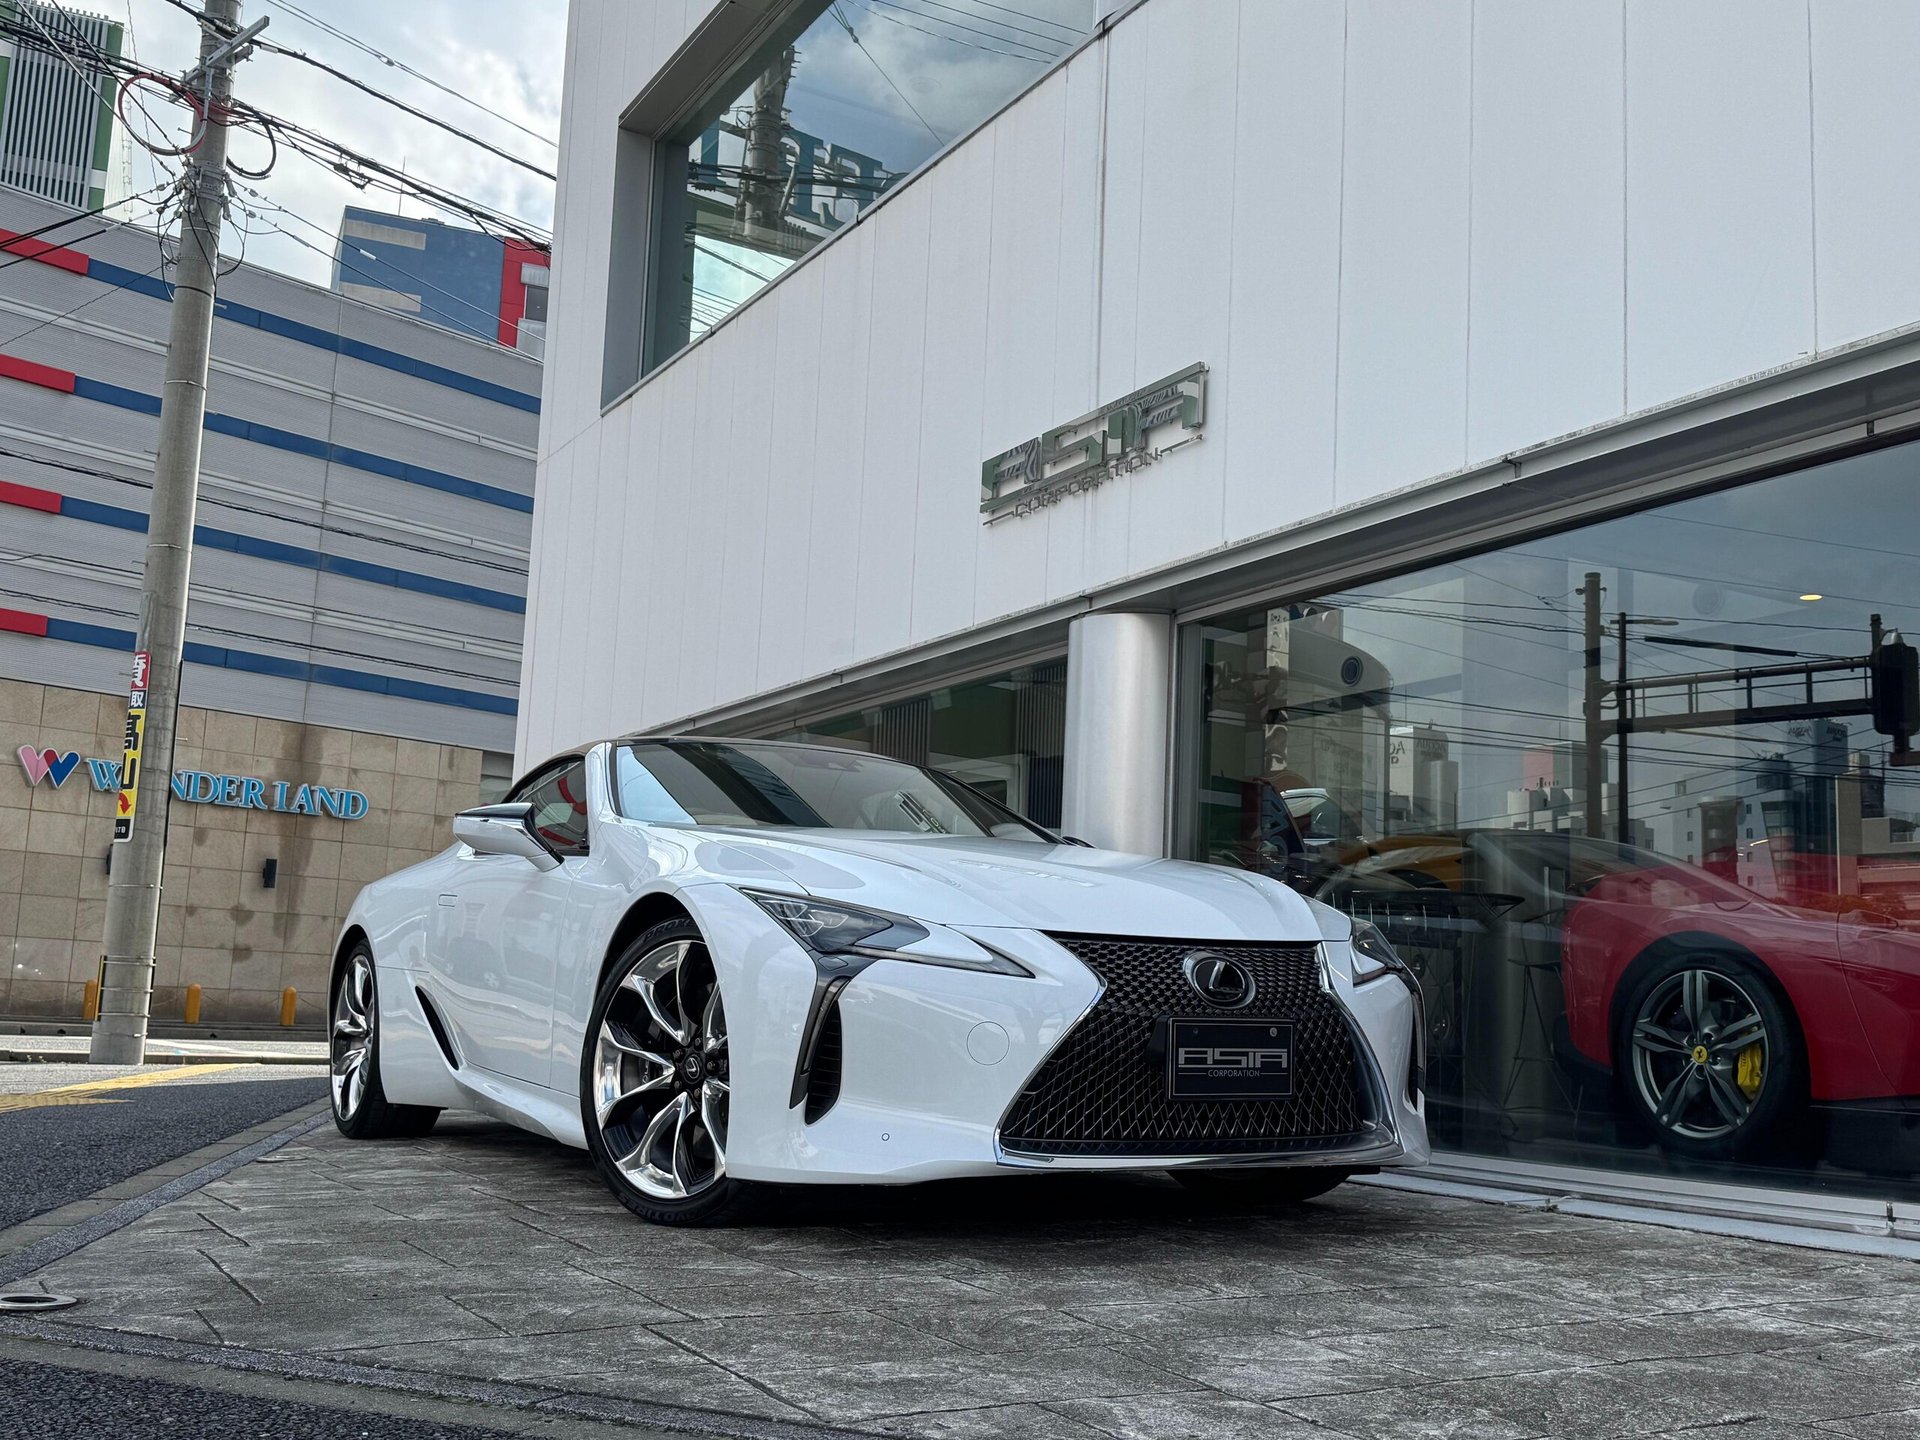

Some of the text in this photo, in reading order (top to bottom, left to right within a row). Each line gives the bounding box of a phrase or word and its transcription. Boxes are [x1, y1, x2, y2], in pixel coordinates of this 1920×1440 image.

[1015, 448, 1162, 518] CORPORATION
[84, 757, 370, 821] WNDER LAND
[1178, 1047, 1288, 1068] ASIA
[1207, 1069, 1260, 1078] CORPORATION
